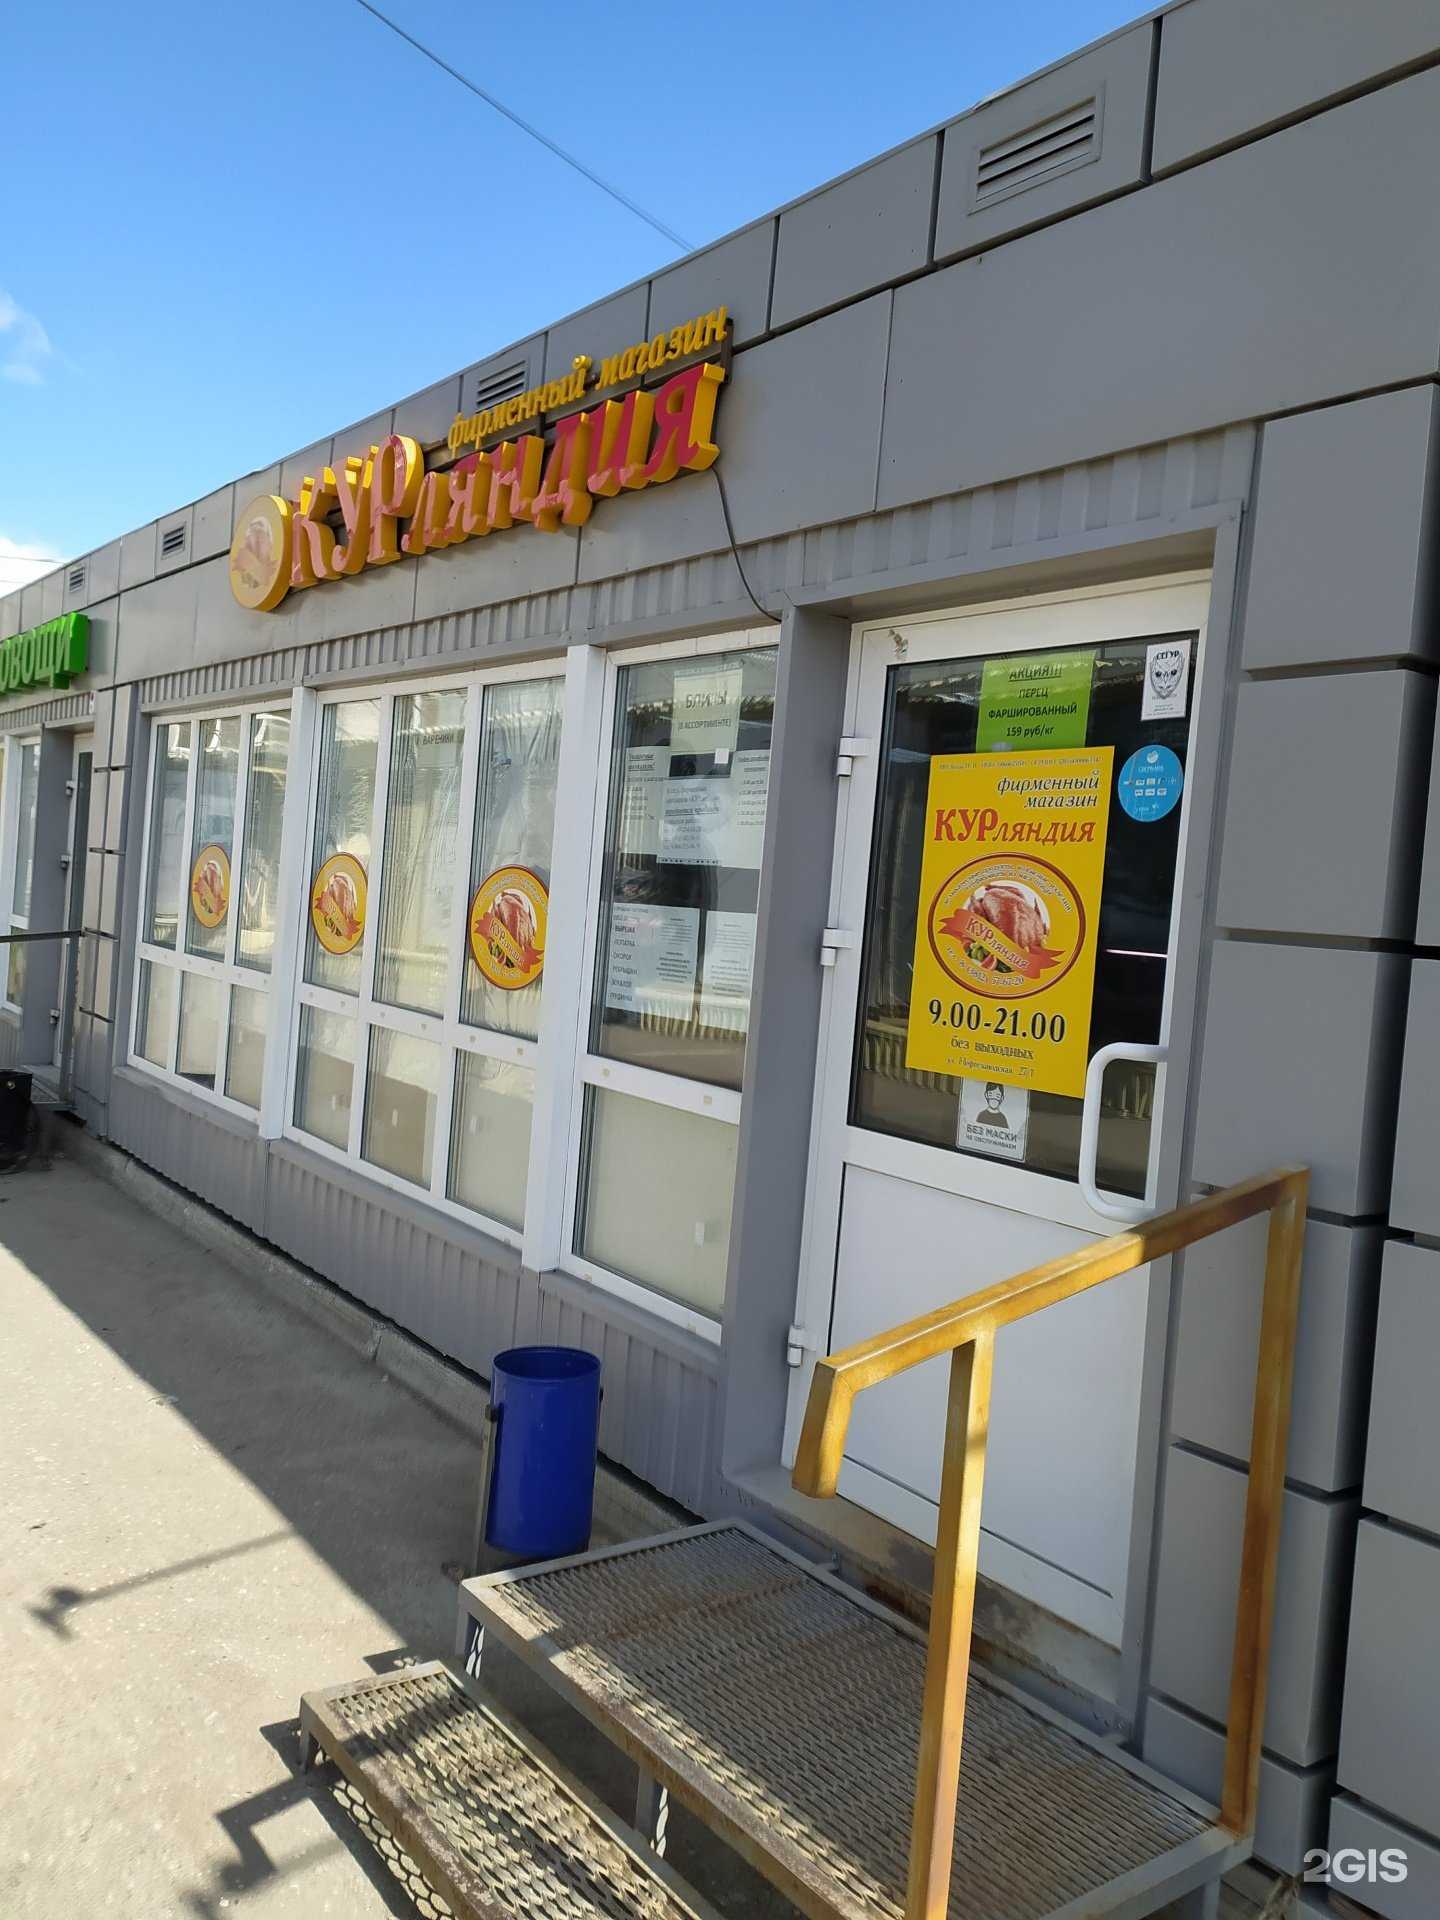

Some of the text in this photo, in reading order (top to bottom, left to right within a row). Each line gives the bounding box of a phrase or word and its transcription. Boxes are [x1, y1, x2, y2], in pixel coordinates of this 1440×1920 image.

[447, 306, 728, 451] фирменный магазин
[0, 612, 86, 693] ОВОЩИ
[1018, 688, 1049, 699] ПЕРЕЦ
[988, 701, 1078, 719] ФАРШИРОВАННЫЙ
[1006, 723, 1054, 738] 159 руб/кг
[998, 768, 1100, 795] фирменный
[1024, 793, 1097, 808] магазин
[928, 999, 1066, 1043] 9.00-21.00
[966, 1123, 1018, 1143] БЕЗ МАСКИ
